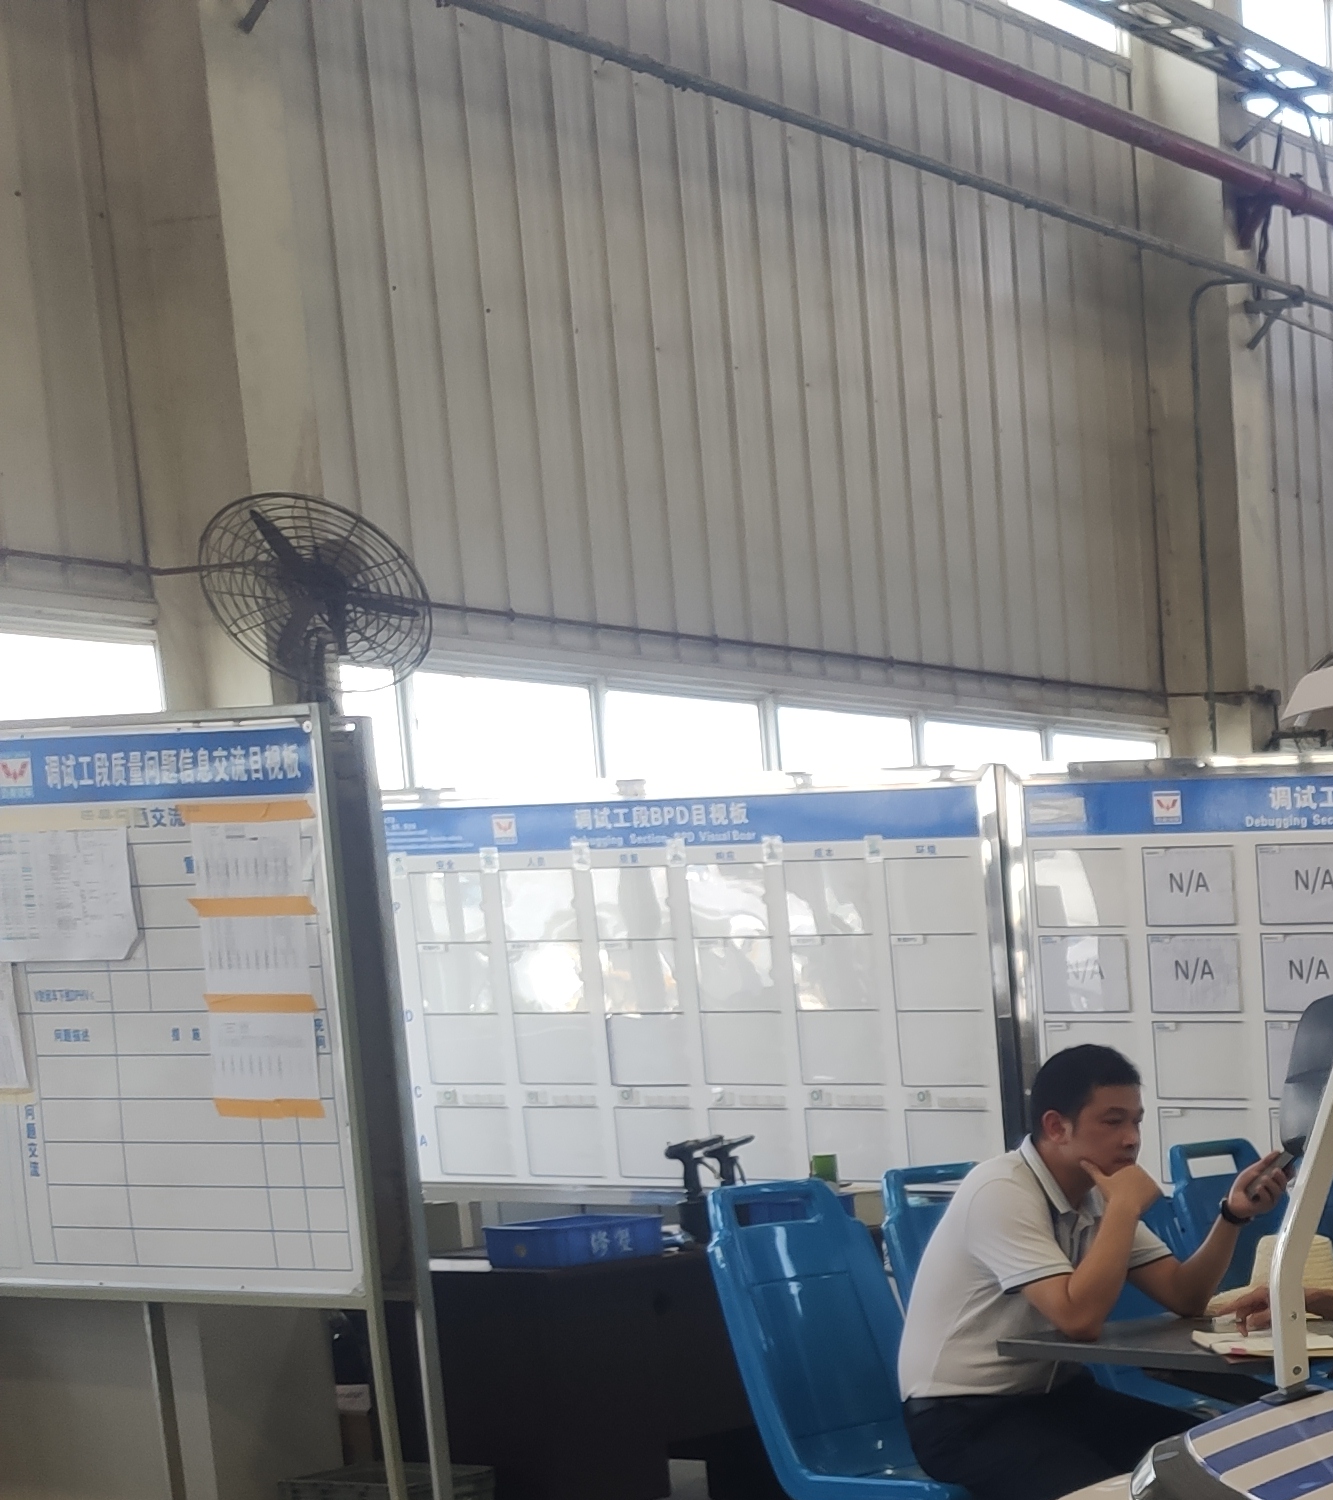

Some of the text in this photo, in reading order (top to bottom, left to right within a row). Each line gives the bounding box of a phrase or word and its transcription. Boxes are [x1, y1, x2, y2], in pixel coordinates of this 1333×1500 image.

[575, 802, 749, 830] 调试工段BPD目视板
[1245, 815, 1308, 828] Debugging
[1168, 871, 1210, 898] N/A
[1067, 959, 1105, 984] N/A
[1174, 957, 1215, 985] N/A
[1288, 957, 1330, 985] N/A
